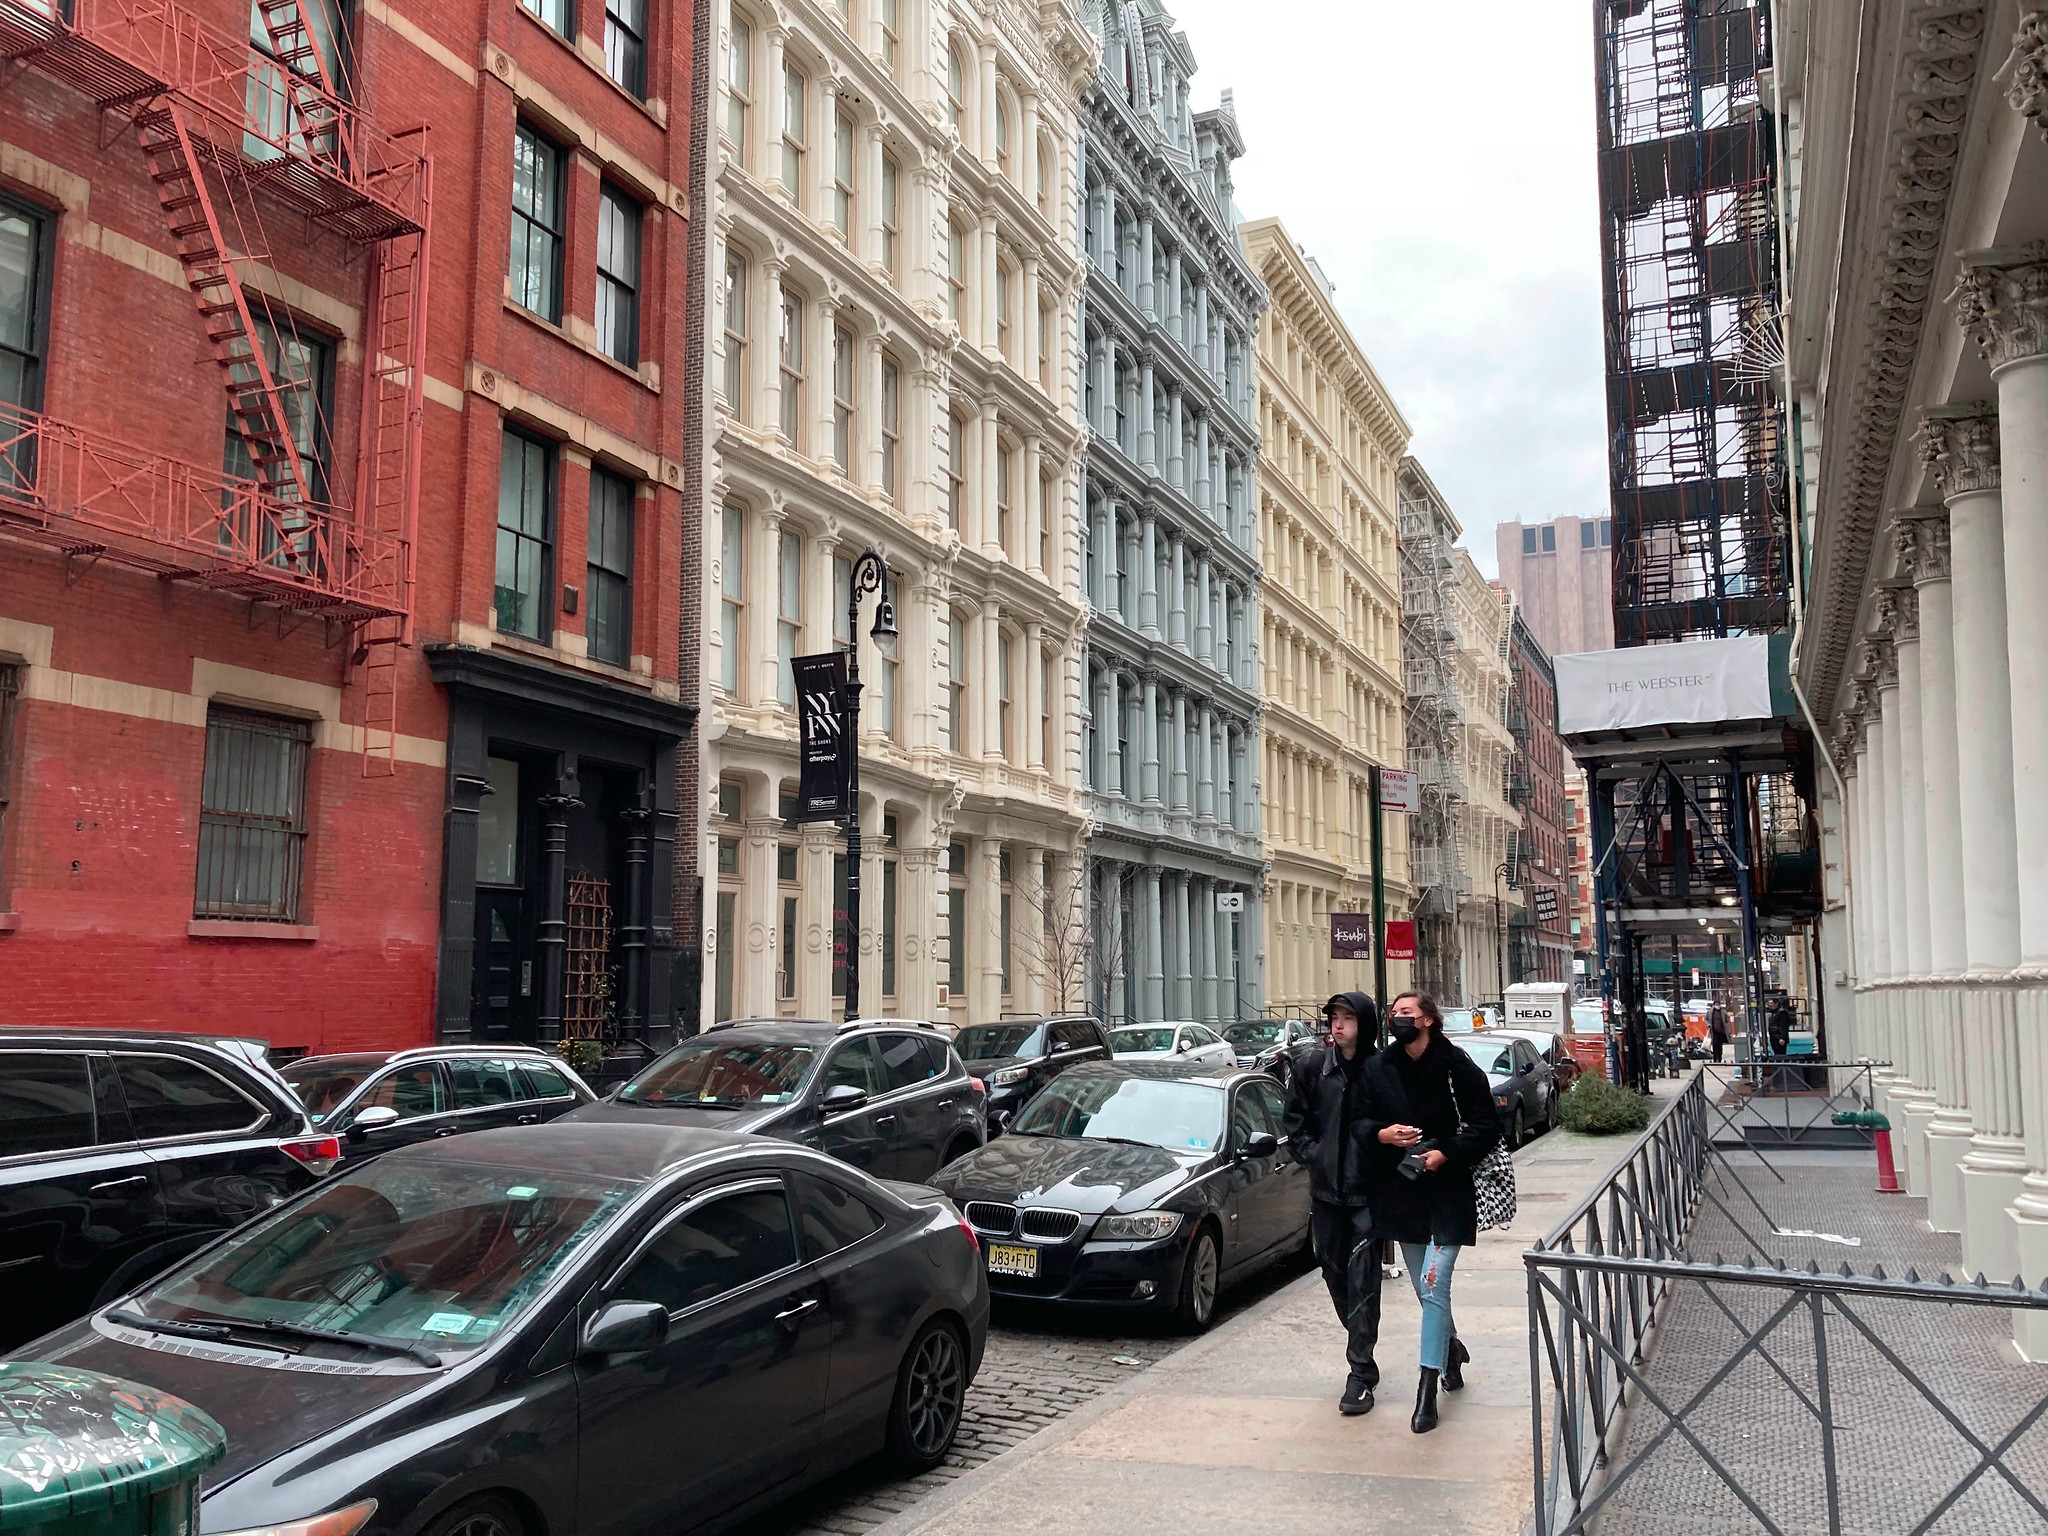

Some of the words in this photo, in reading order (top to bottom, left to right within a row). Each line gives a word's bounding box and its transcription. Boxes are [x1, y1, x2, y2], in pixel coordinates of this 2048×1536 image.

[1607, 681, 1633, 693] THE
[1638, 675, 1703, 689] WEBSTER
[804, 690, 836, 716] NY
[1382, 771, 1408, 783] PARKING
[1393, 783, 1408, 793] Friday
[1535, 892, 1555, 902] BLUE
[1514, 1009, 1552, 1018] HEAD
[989, 1267, 1015, 1275] PARK
[1016, 1270, 1034, 1278] AVE
